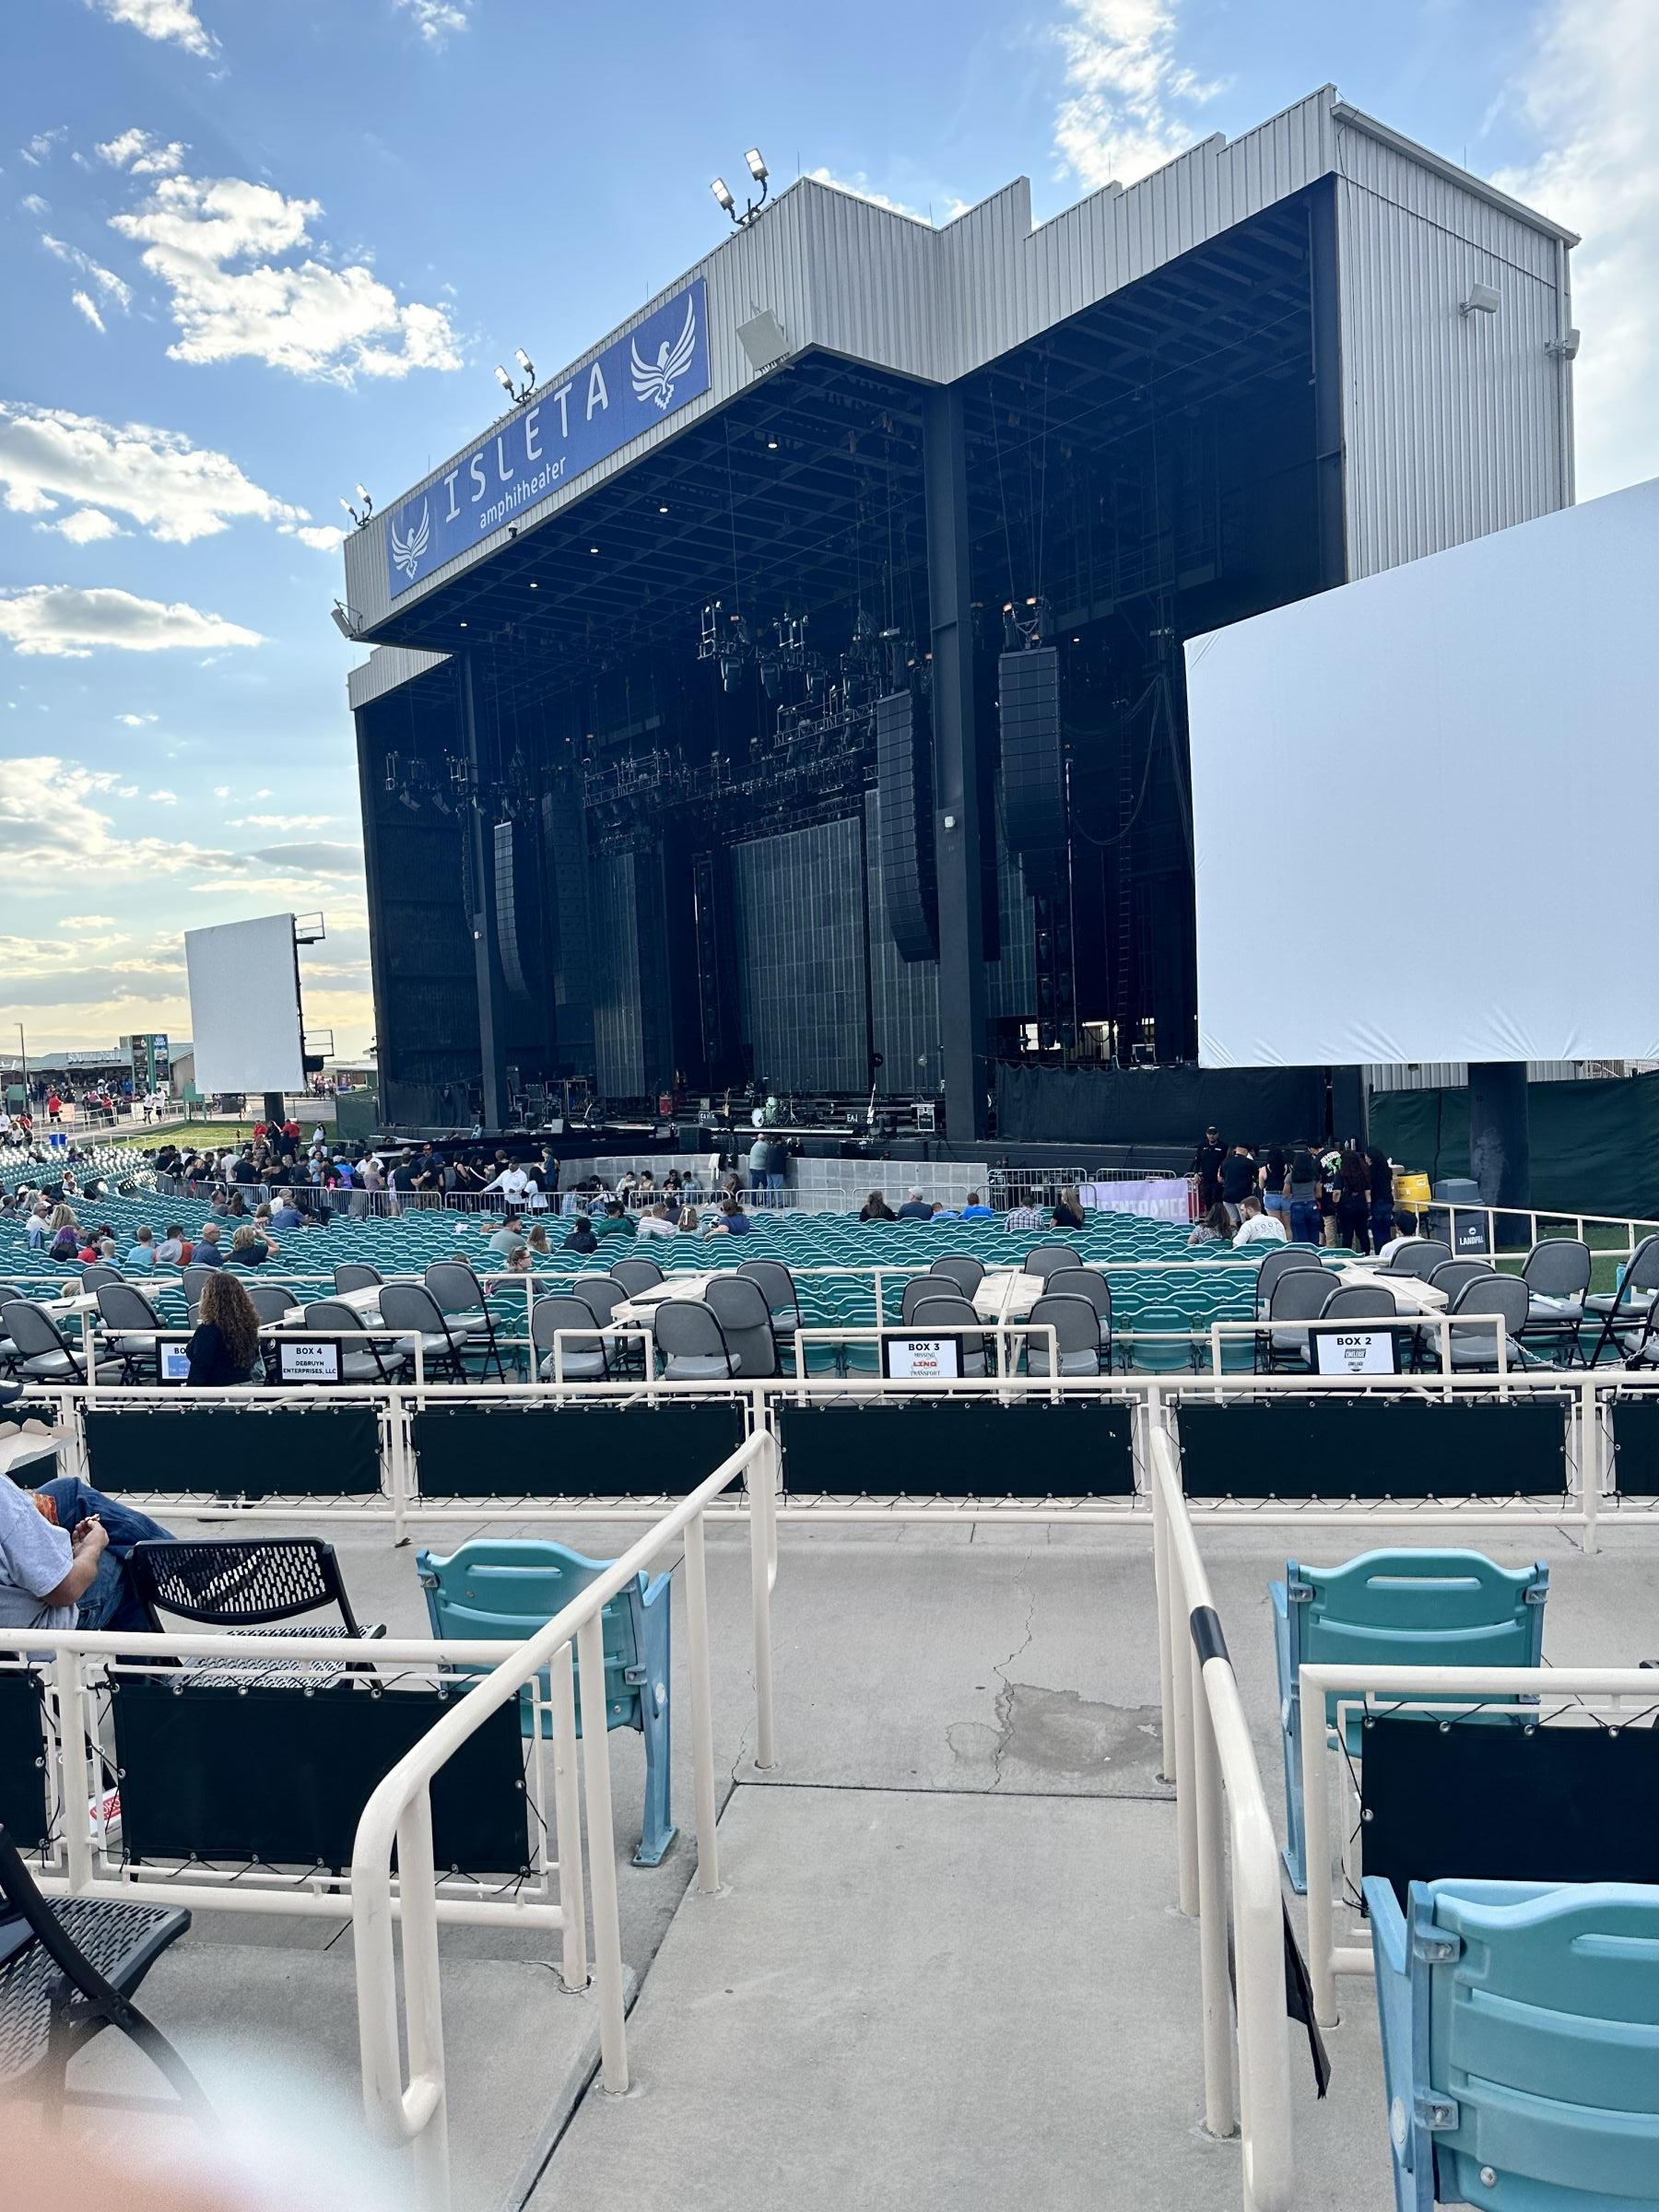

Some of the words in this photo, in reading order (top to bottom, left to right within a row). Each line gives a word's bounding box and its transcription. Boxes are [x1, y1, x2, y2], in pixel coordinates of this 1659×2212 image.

[443, 361, 609, 524] ISLETA
[479, 456, 567, 529] amphitheater
[1459, 1235, 1484, 1245] LANDFILL
[1336, 1336, 1361, 1346] BOX
[1366, 1336, 1371, 1345] 2
[296, 1347, 314, 1355] BOX
[317, 1347, 323, 1355] 4
[908, 1343, 930, 1351] BOX
[934, 1343, 940, 1351] 3
